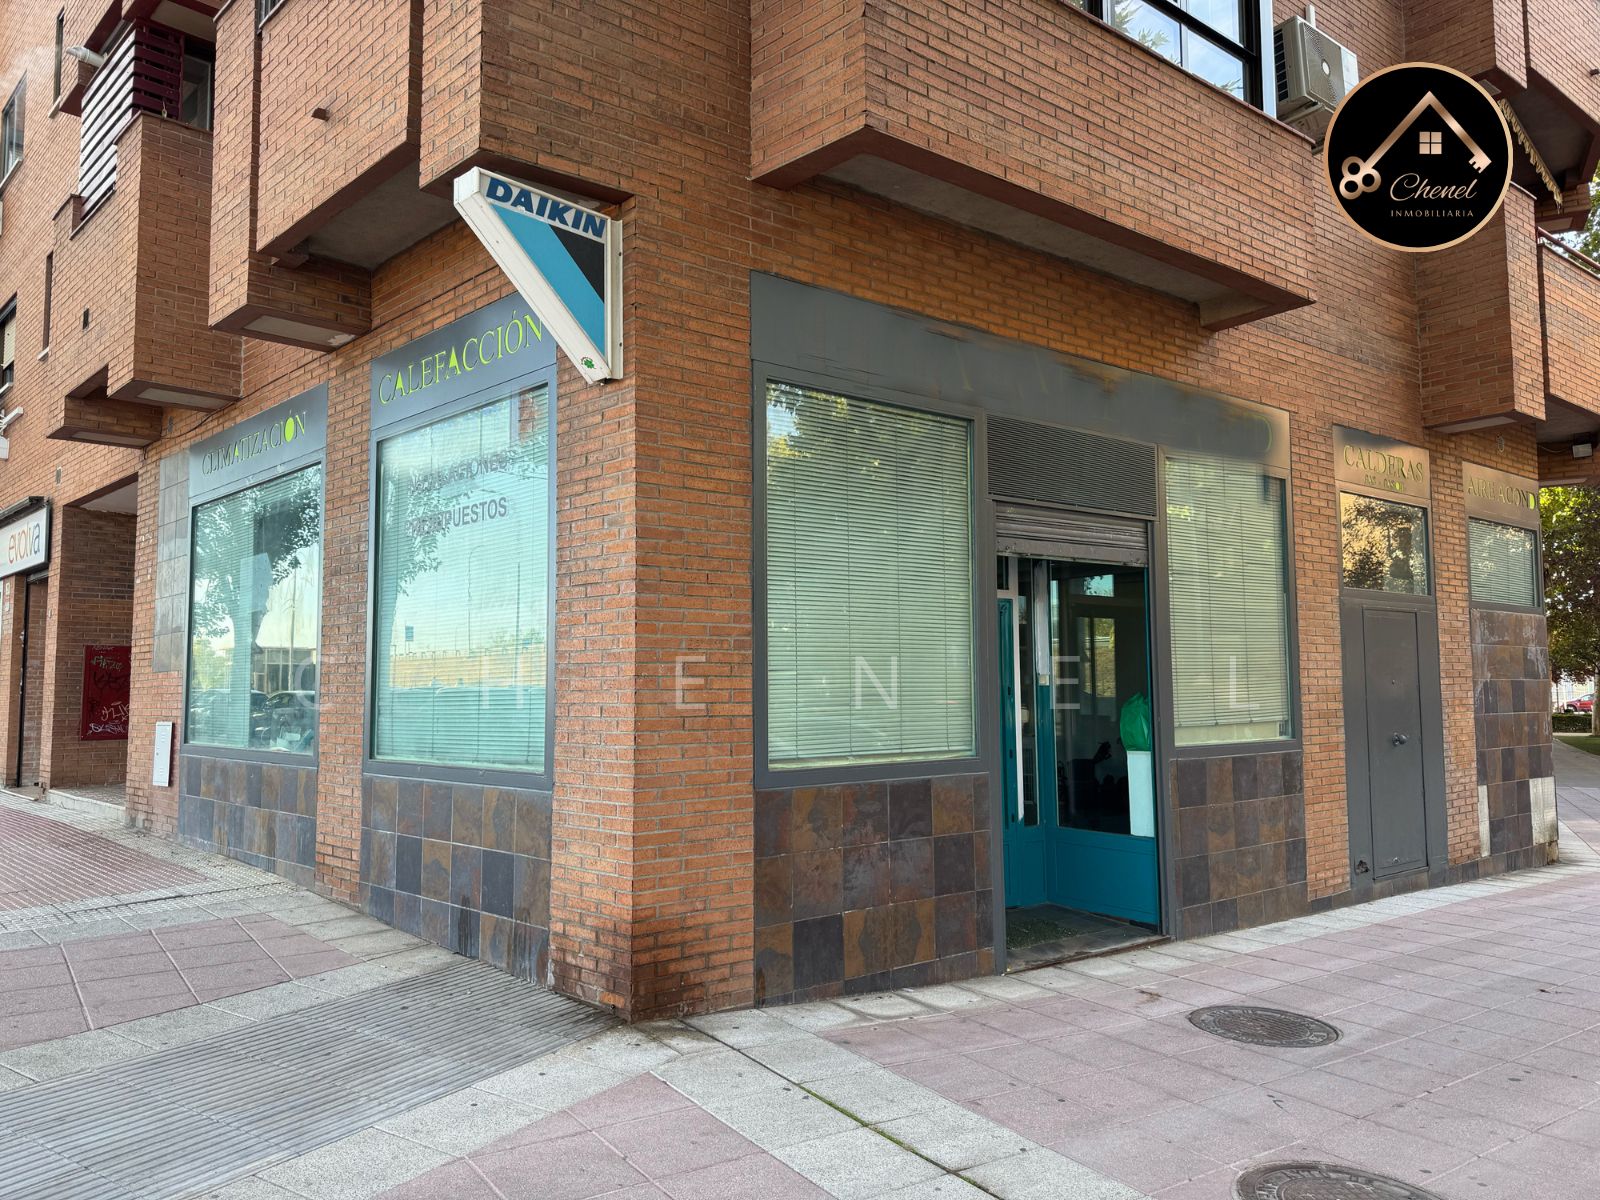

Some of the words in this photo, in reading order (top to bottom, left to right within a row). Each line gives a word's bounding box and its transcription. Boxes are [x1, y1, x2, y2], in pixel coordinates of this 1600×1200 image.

[486, 177, 606, 239] DAIKIN
[378, 310, 543, 405] CALEFACCIÓN
[201, 409, 307, 476] CLIMATIZACIÓN
[1343, 444, 1425, 484] CALDERAS
[1468, 476, 1496, 500] AIRE
[8, 521, 41, 564] evolva
